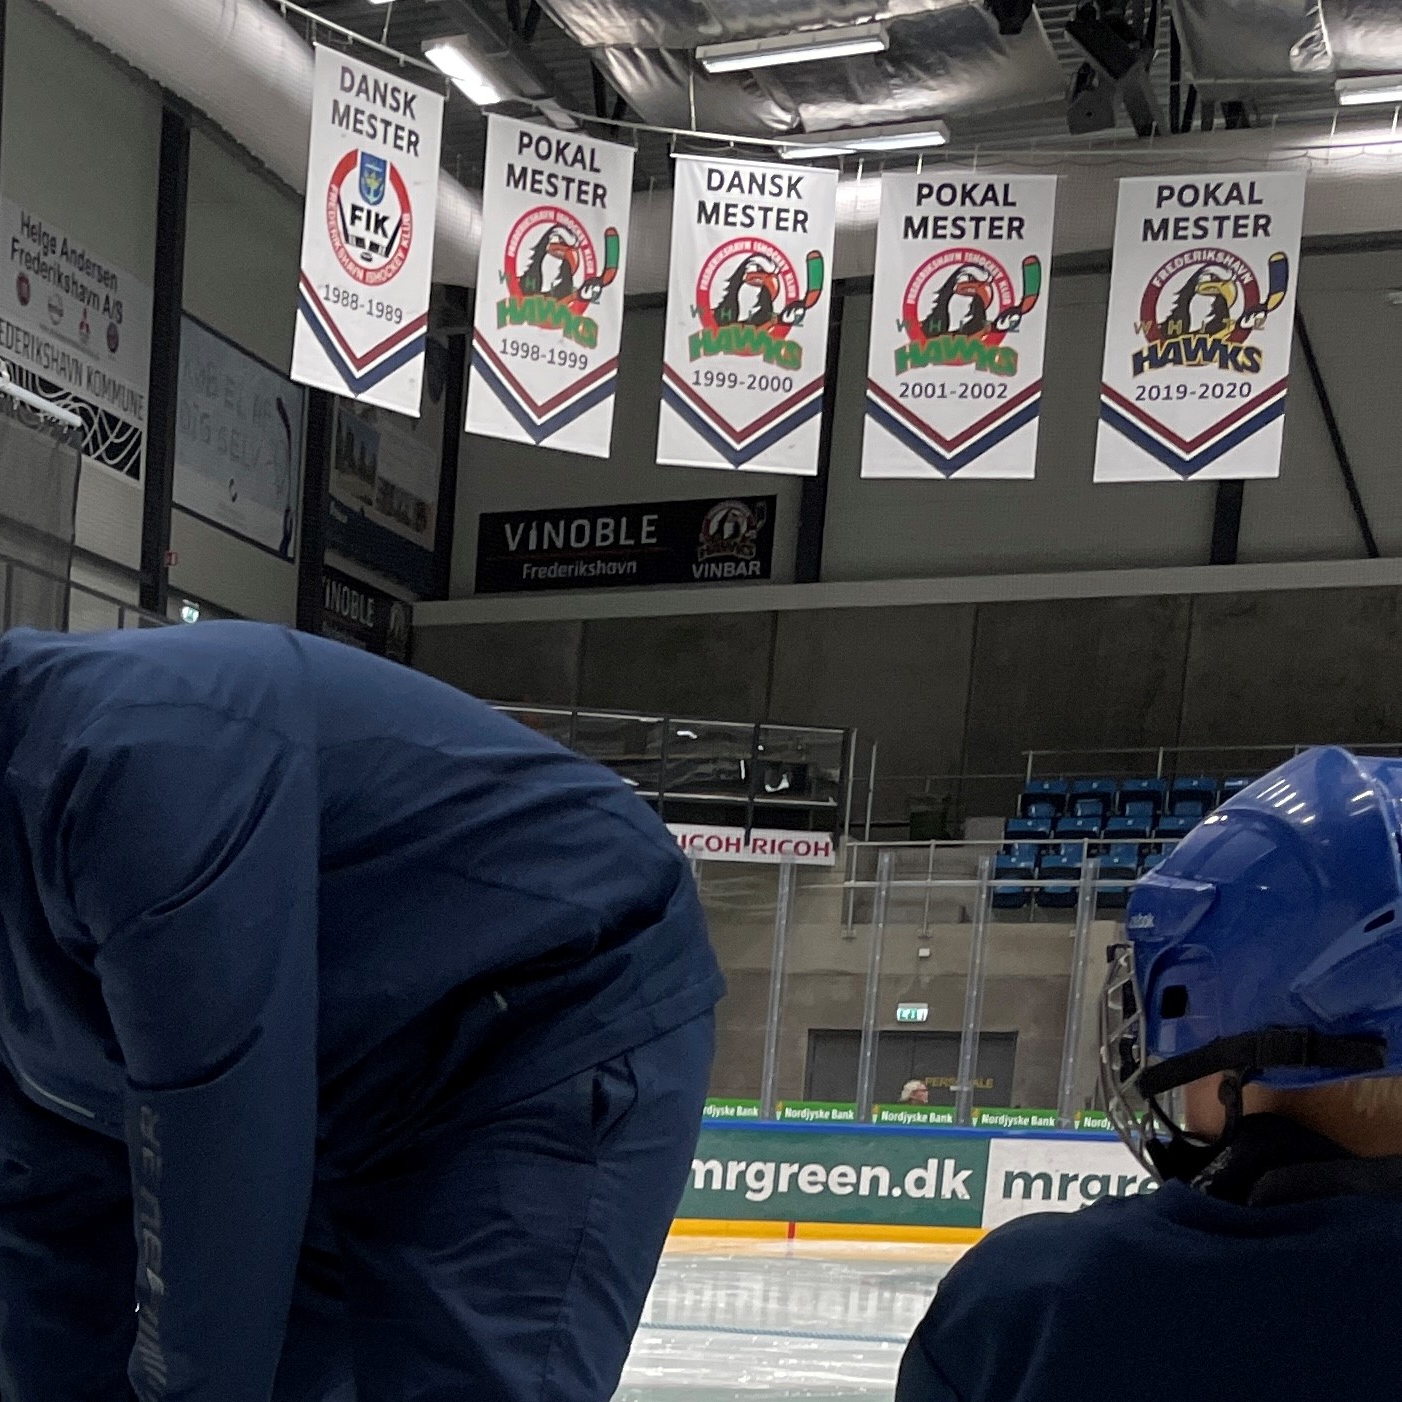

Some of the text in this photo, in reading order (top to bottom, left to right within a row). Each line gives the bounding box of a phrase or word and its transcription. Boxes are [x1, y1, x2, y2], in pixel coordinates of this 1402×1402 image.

[340, 66, 417, 120] DANSK
[331, 99, 420, 157] MESTER
[518, 130, 602, 173] POKAL
[506, 163, 608, 209] MESTER
[707, 167, 804, 200] DANSK
[916, 182, 1018, 208] POKAL
[1156, 181, 1265, 209] POKAL
[350, 203, 390, 239] FIK
[697, 200, 809, 234] MESTER
[903, 215, 1025, 240] MESTER
[1142, 213, 1273, 243] MESTER
[21, 210, 119, 293] Helge Andersen
[10, 235, 124, 325] Frederikshavn A/S
[1151, 250, 1254, 288] FREDERIKSHAVN
[323, 284, 403, 325] 1988-1989
[499, 338, 588, 371] 1998-1999
[1132, 336, 1264, 379] HAWKS
[692, 369, 793, 393] 1999-2000
[899, 382, 1009, 400] 2001-2002
[1135, 381, 1252, 402] 2019-2020
[504, 514, 660, 552] VINOBLE
[522, 558, 638, 580] Frederikshavn
[691, 560, 762, 579] VINBAR
[751, 837, 830, 857] RICOH
[926, 1076, 994, 1089] PERSALE
[737, 1106, 759, 1117] Bank
[784, 1106, 855, 1121] Nordjyske Bank
[881, 1109, 953, 1124] Nordjyske Bank
[981, 1113, 1055, 1128] Nordjyske Bank
[691, 1157, 974, 1202] mrgreen.dk
